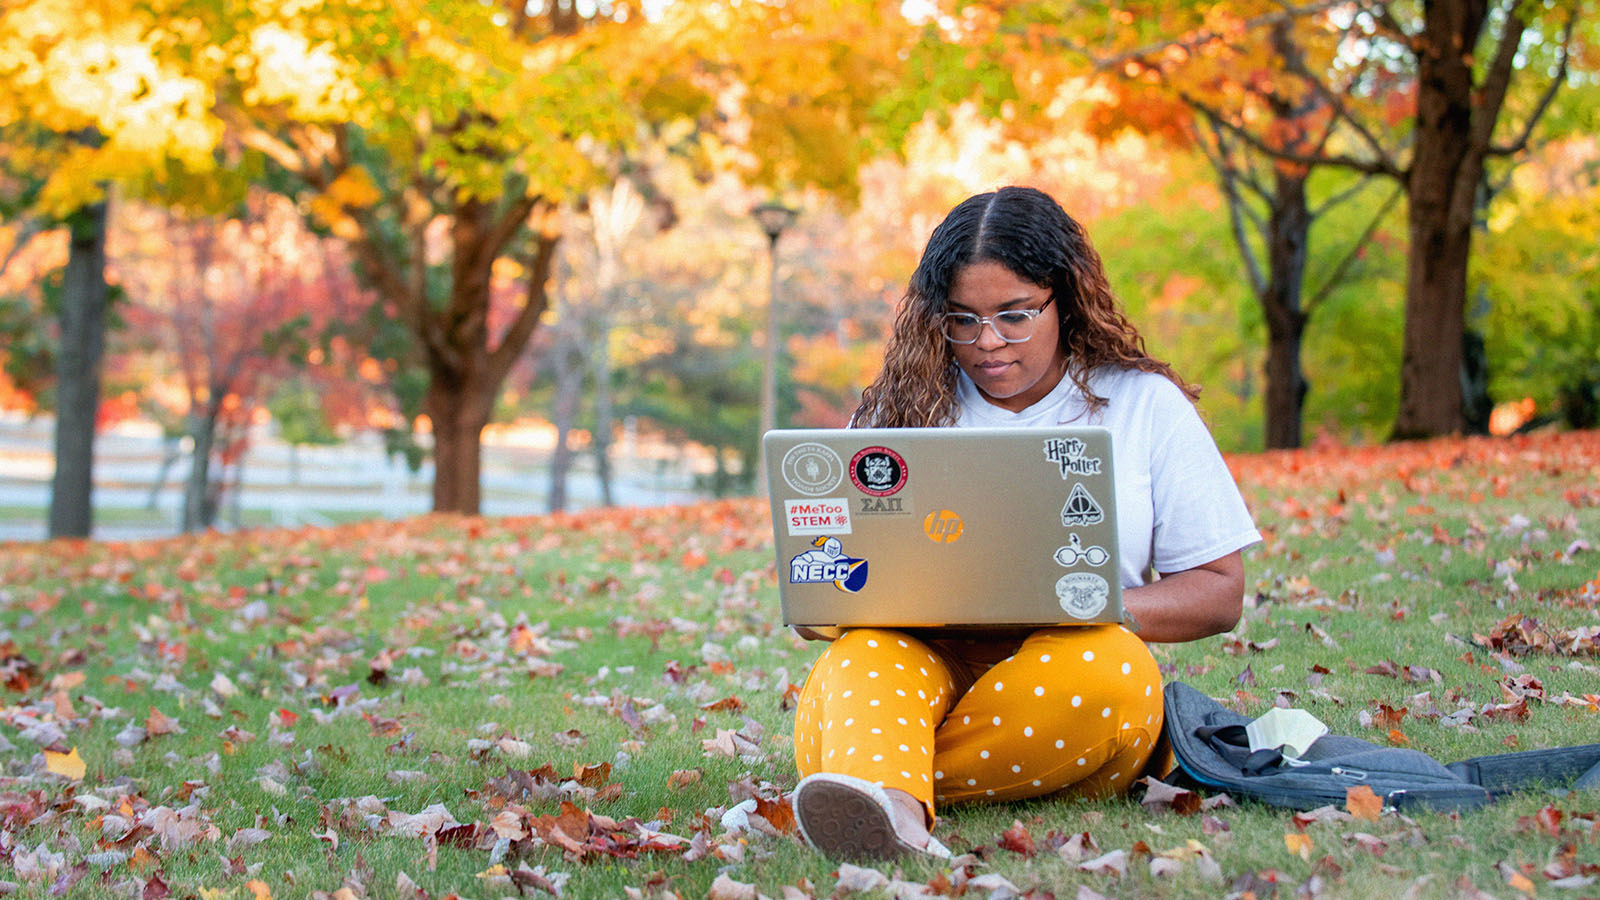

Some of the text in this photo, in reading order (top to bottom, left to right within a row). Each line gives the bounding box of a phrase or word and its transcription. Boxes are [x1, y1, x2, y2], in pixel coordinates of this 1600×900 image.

[1047, 439, 1084, 460] Harry
[1061, 455, 1100, 475] Potter
[790, 504, 843, 515] #MeToo
[791, 516, 831, 527] STEM
[926, 509, 961, 543] hp
[792, 563, 850, 581] NECC
